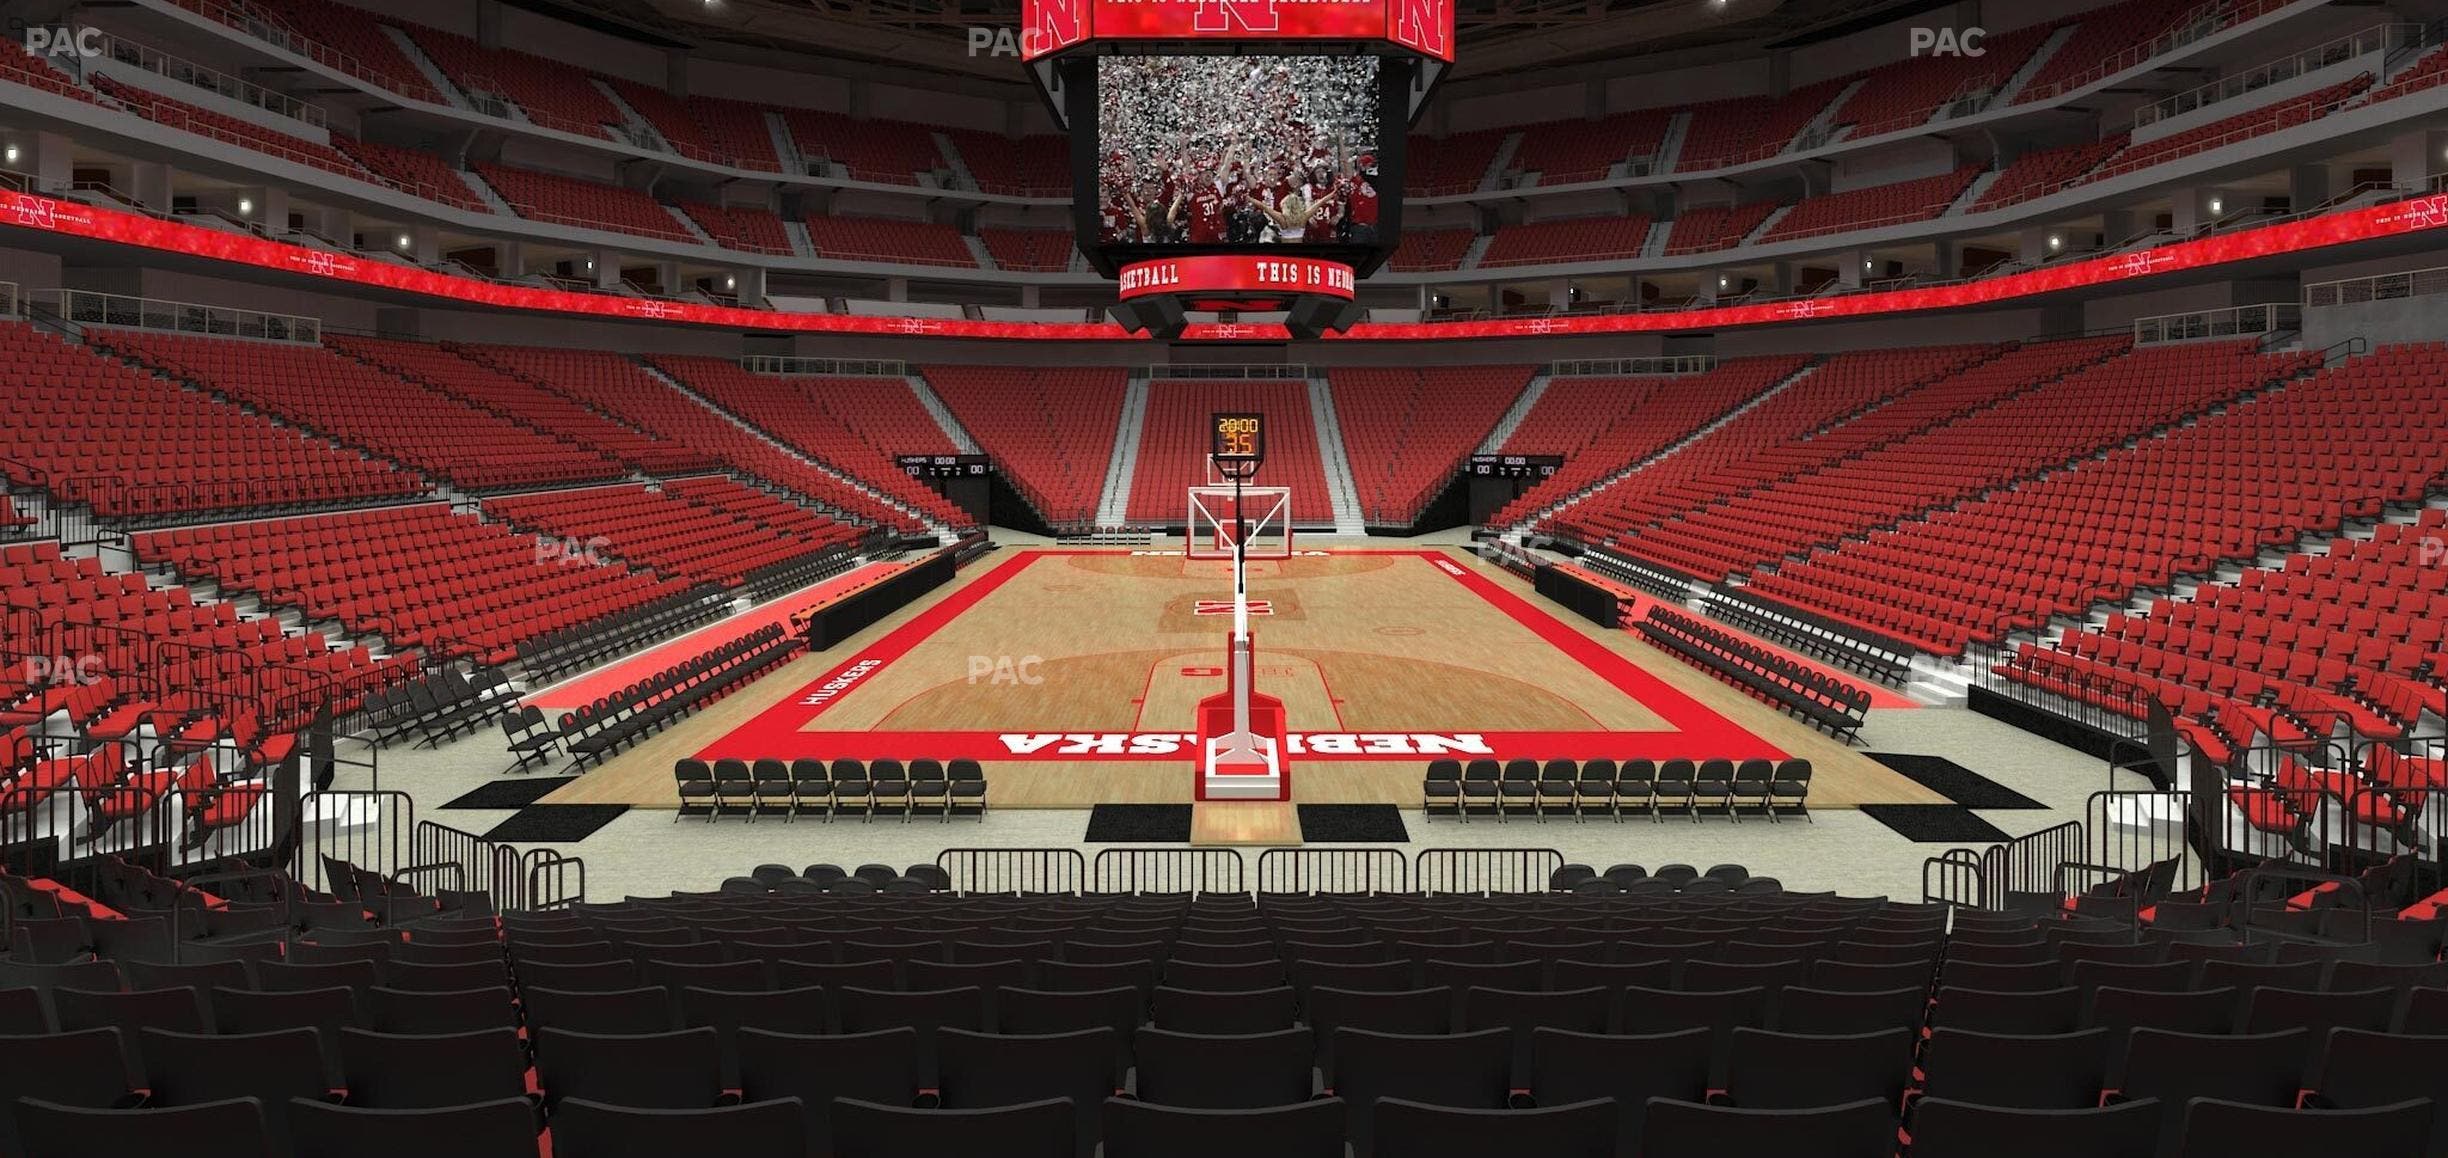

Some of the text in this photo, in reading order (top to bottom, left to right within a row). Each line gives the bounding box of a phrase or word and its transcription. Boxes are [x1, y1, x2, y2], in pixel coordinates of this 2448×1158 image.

[1257, 261, 1298, 283] THIS
[1307, 264, 1322, 285] IS
[1219, 418, 1258, 432] 20:00
[798, 659, 882, 705] HUSKERS
